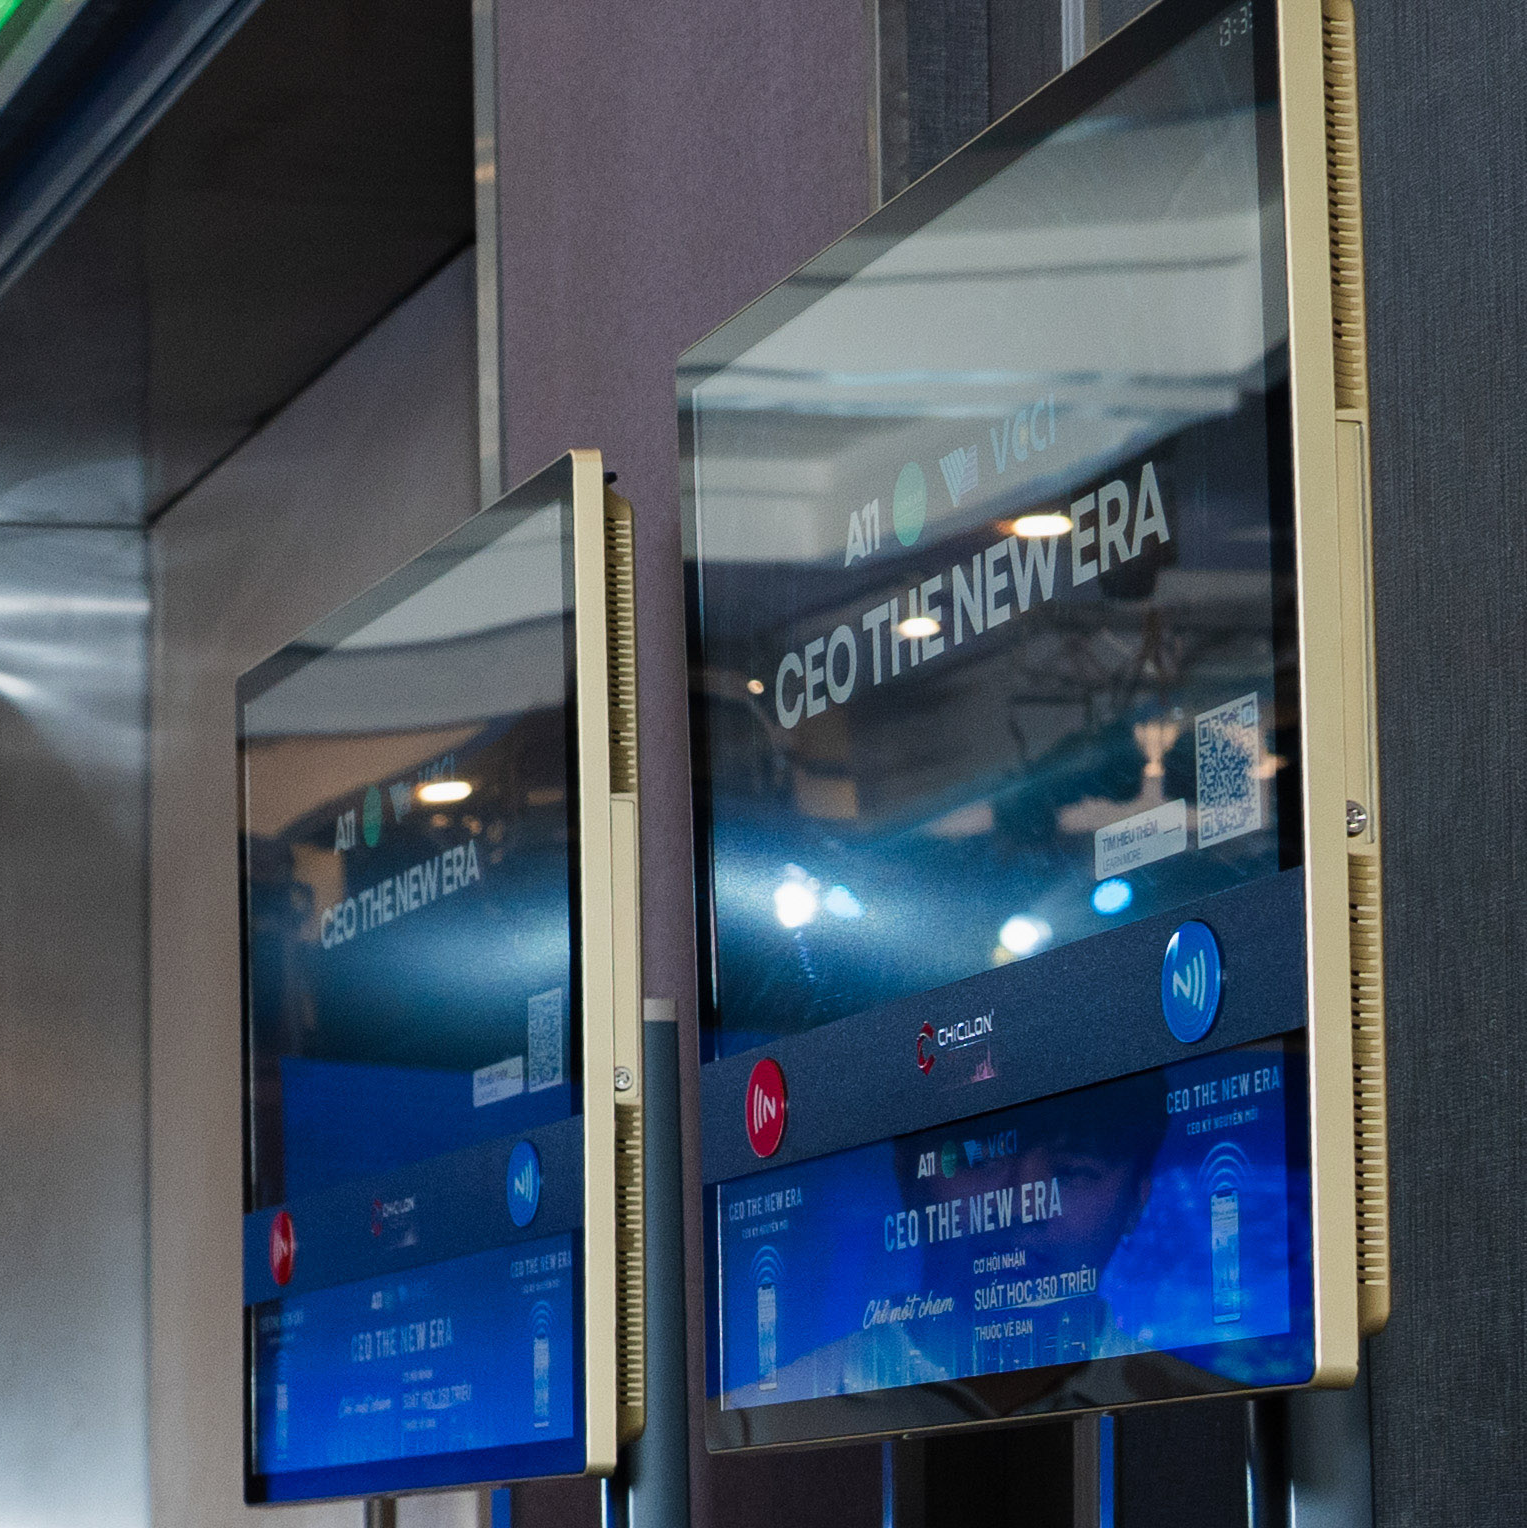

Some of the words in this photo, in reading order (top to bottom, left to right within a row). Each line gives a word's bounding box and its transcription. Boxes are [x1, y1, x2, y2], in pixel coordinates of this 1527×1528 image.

[990, 390, 1056, 475] VCCI
[775, 625, 857, 729] CEO
[862, 574, 945, 687] THE
[952, 510, 1062, 646] NEW
[1070, 461, 1171, 588] ERA
[320, 896, 357, 950] CEO
[358, 877, 395, 932] THE
[395, 856, 440, 918] NEW
[442, 838, 480, 895] ERA
[1166, 1088, 1190, 1114] CEO
[1193, 1081, 1218, 1108] THE
[1221, 1072, 1250, 1101] NEW
[1254, 1065, 1281, 1093] ERA
[987, 1127, 1018, 1158] VCCI
[728, 1201, 745, 1221] CEO
[746, 1196, 763, 1218] THE
[764, 1190, 783, 1213] NEW
[785, 1186, 803, 1208] ERA
[884, 1208, 919, 1252] CEO
[925, 1199, 963, 1243] THE
[969, 1187, 1014, 1235] NEW
[1021, 1177, 1063, 1224] ERA
[890, 1294, 922, 1328] một
[918, 1290, 955, 1322] chạm
[974, 1279, 1005, 1312] SUẤT
[1035, 1275, 1058, 1299] 350
[350, 1331, 373, 1362] CEO
[375, 1327, 397, 1359] THE
[400, 1321, 427, 1354] NEW
[429, 1315, 453, 1349] ERA
